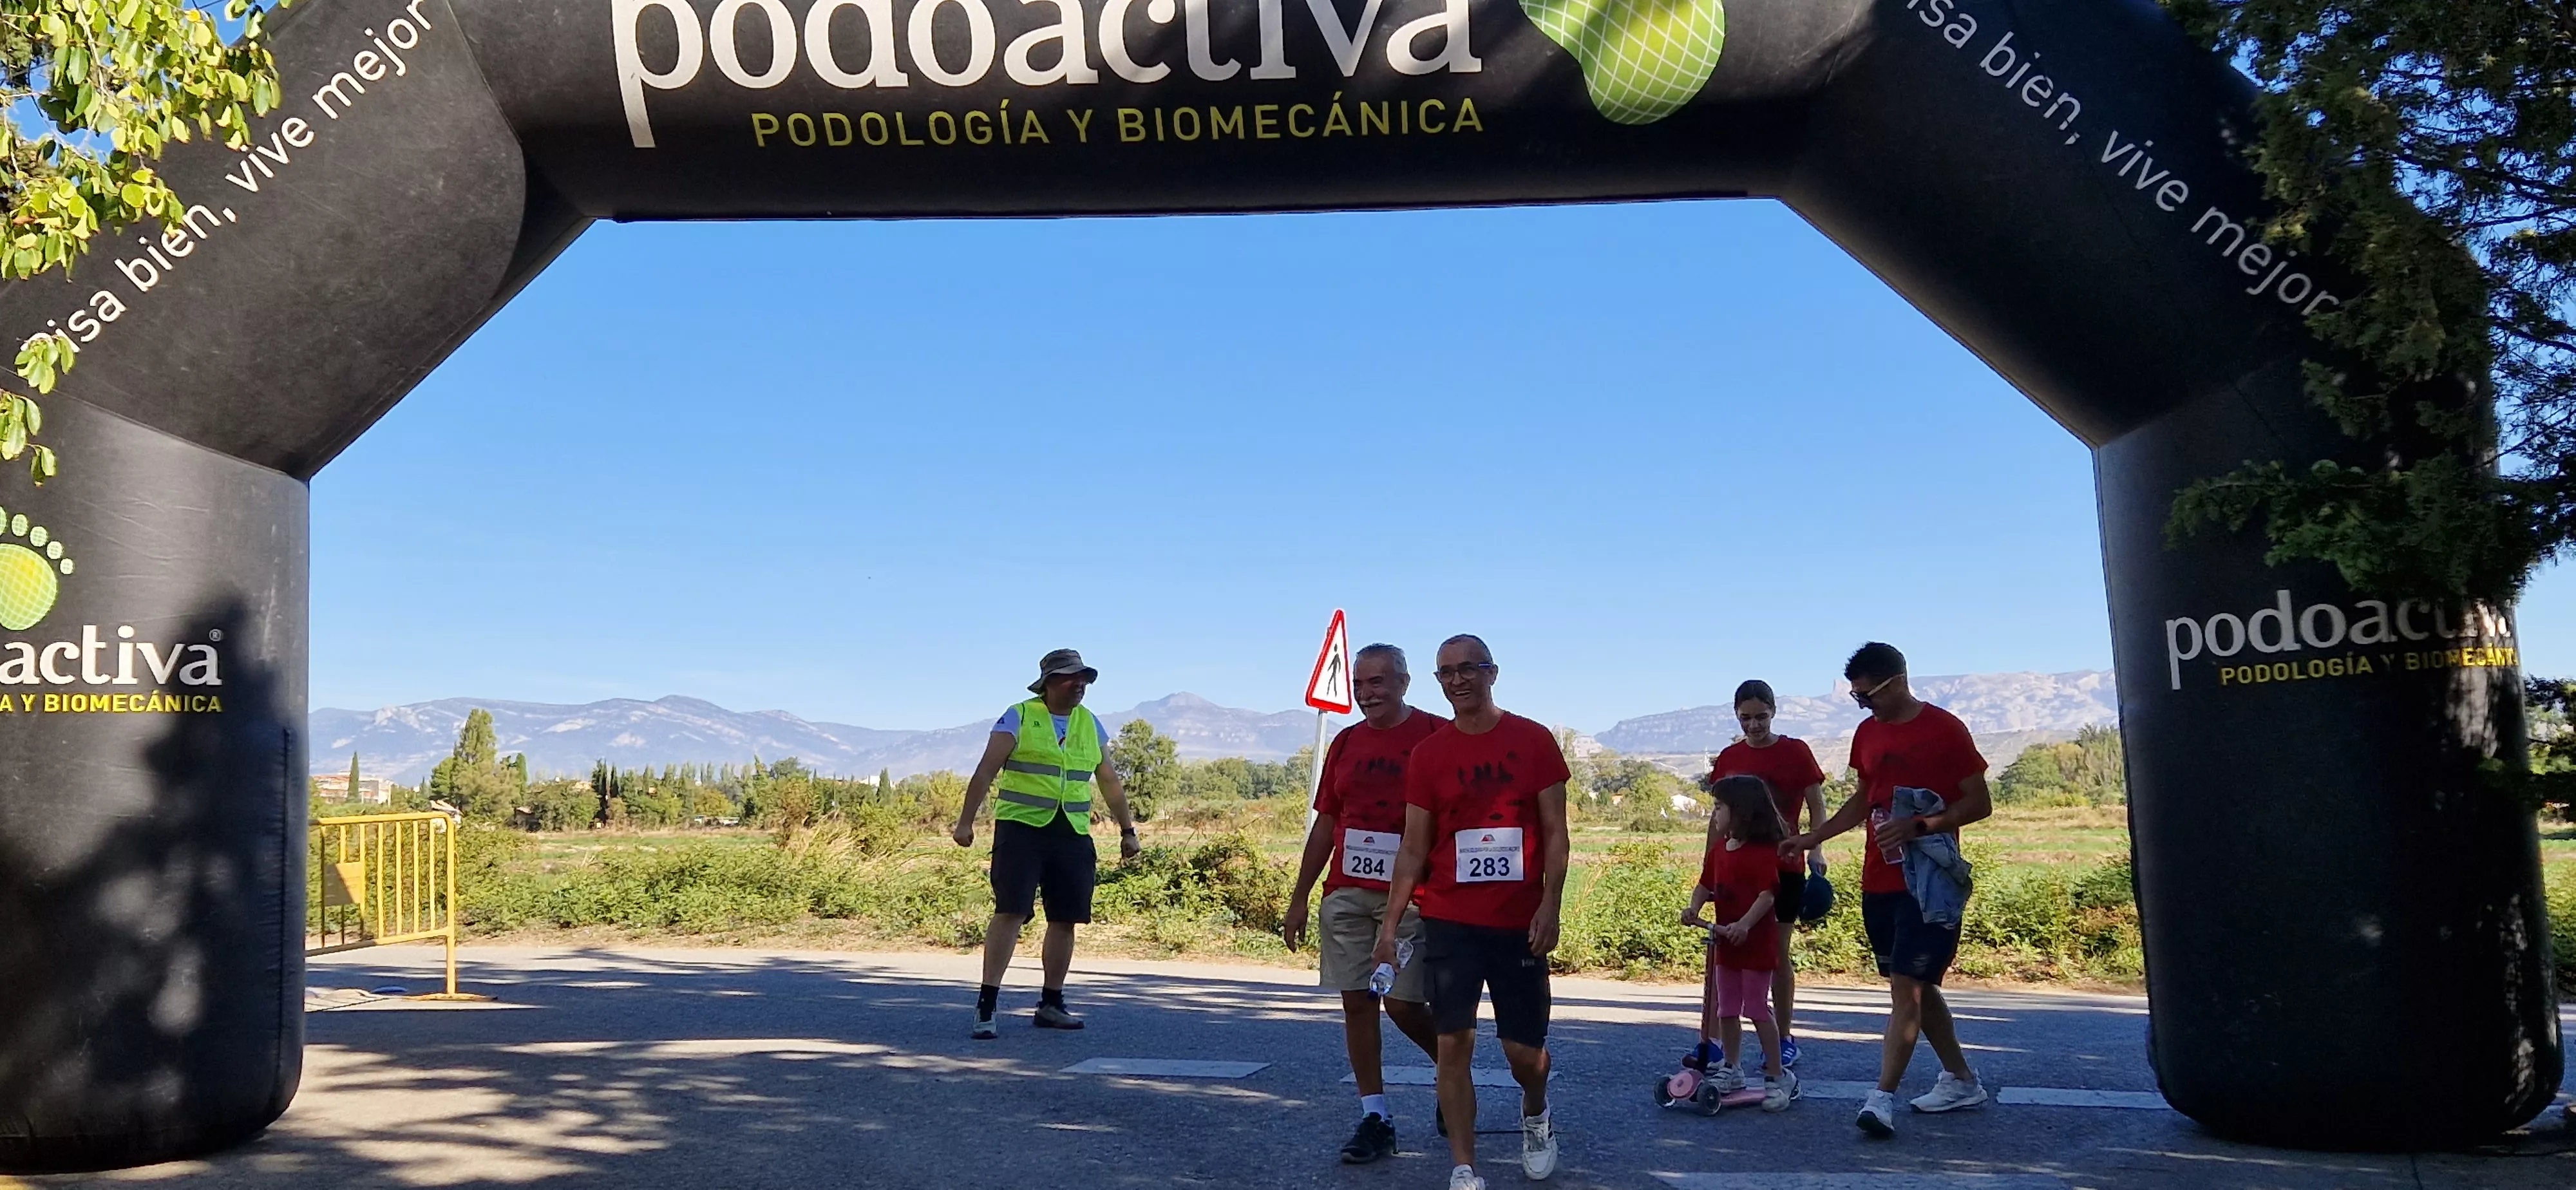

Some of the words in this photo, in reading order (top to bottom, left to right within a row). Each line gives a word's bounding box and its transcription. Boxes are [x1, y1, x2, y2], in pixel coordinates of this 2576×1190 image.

[751, 99, 1050, 147] PODOLOGÍA
[1066, 109, 1094, 144] Y
[1117, 91, 1483, 142] BIOMECÁNICA
[114, 205, 236, 292] bien,
[224, 115, 315, 192] vive
[313, 0, 431, 120] mejor
[1979, 31, 2081, 145] bien,
[2101, 130, 2189, 211] vive
[2190, 206, 2340, 316] mejor
[2221, 652, 2374, 685] PODOLOGÍA
[2379, 652, 2395, 672] Y
[21, 693, 36, 712] Y
[44, 690, 222, 713] BIOMECÁNICA
[1352, 855, 1385, 876] 284
[1469, 856, 1510, 877] 283
